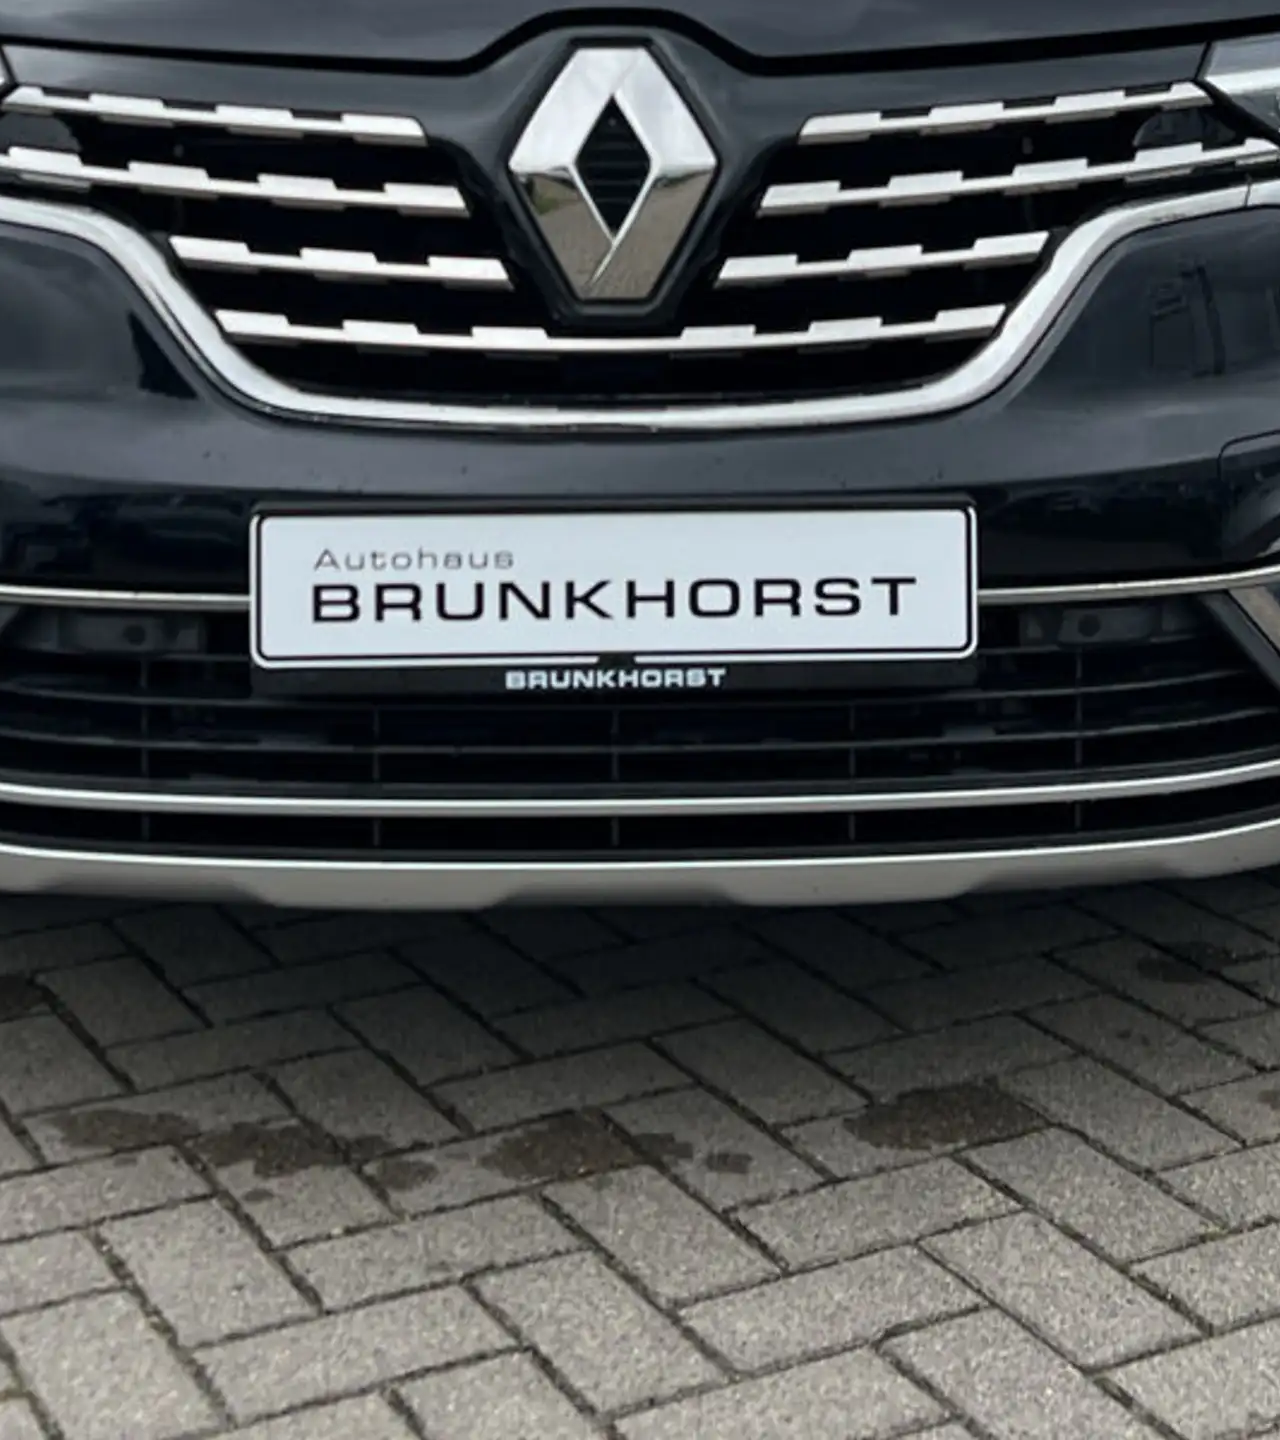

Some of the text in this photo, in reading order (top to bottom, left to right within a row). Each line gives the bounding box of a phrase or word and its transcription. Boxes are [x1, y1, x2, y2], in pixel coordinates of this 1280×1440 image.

[313, 547, 515, 573] Autohaus
[311, 576, 918, 624] BRUNKHORST
[504, 667, 727, 691] BRUNKHORST
